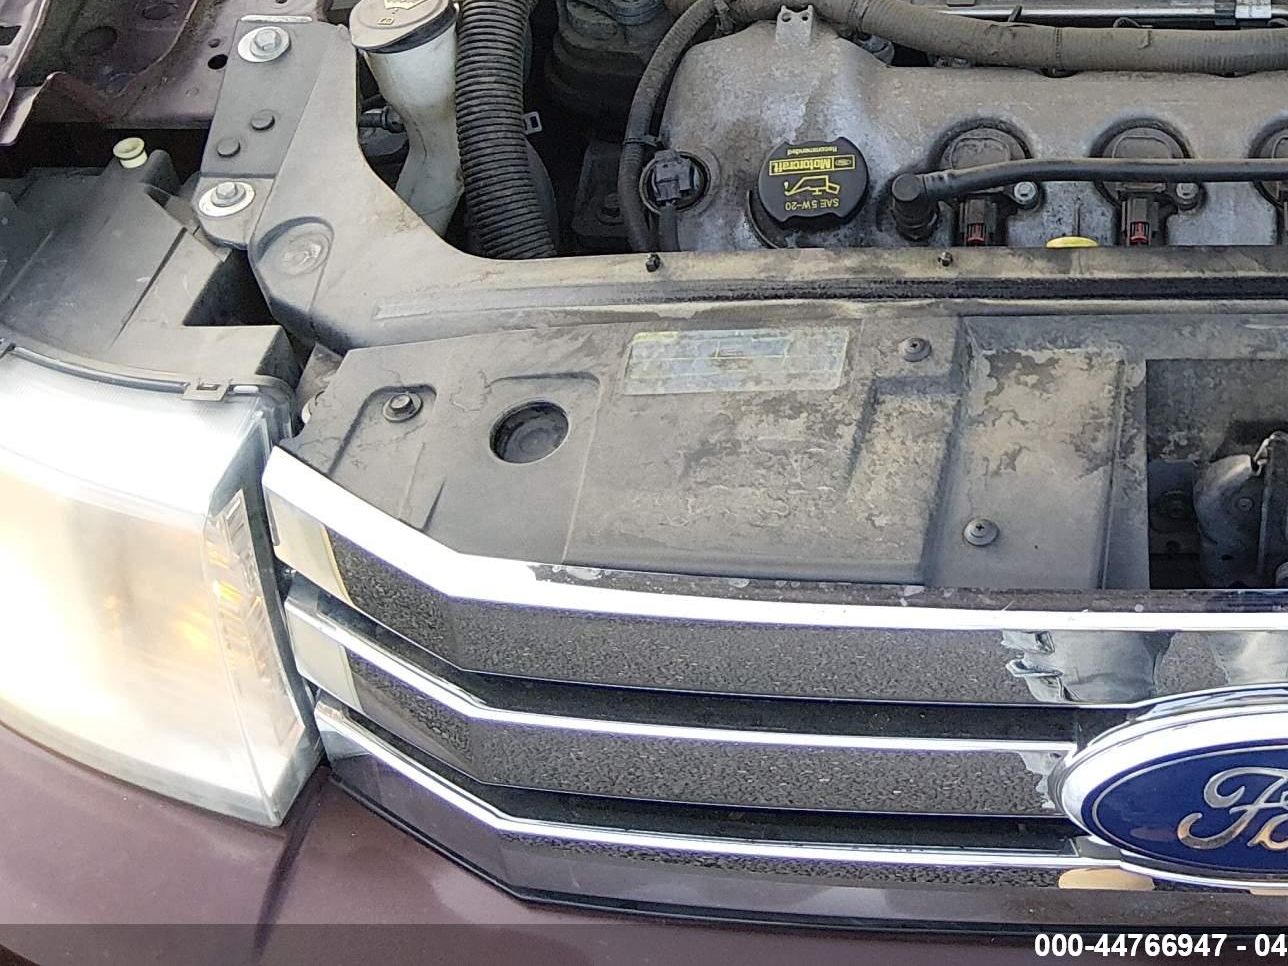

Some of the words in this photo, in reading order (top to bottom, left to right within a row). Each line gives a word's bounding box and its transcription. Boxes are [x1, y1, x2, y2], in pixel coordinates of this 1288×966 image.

[787, 146, 838, 155] Recommended
[773, 158, 831, 172] Motorcraft
[785, 199, 818, 210] 5W-20
[820, 198, 839, 208] SAE
